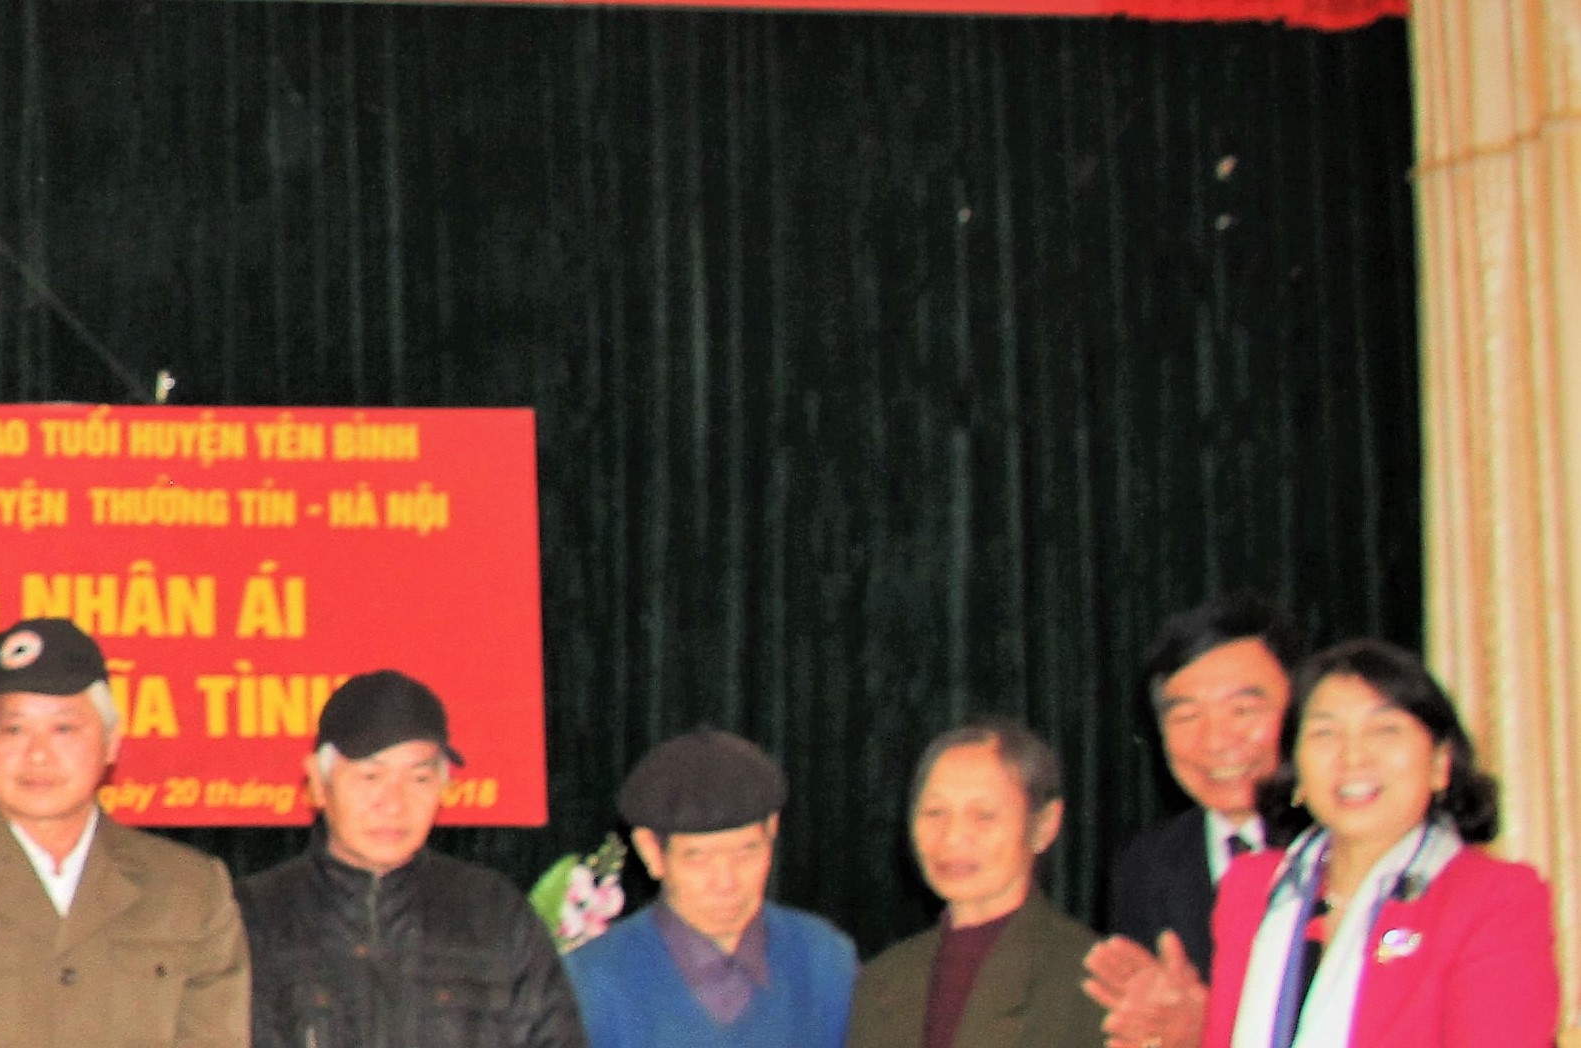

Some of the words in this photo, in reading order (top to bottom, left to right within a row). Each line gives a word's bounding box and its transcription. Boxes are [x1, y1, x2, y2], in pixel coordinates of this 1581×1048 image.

[129, 411, 247, 467] HUYỆN
[255, 412, 324, 460] YÊN
[332, 412, 419, 460] BÌNH
[328, 482, 378, 528] HÀ
[386, 482, 449, 535] NỘI
[22, 559, 216, 638] NHÂN
[236, 559, 306, 638] ÁI
[163, 777, 201, 807] 20
